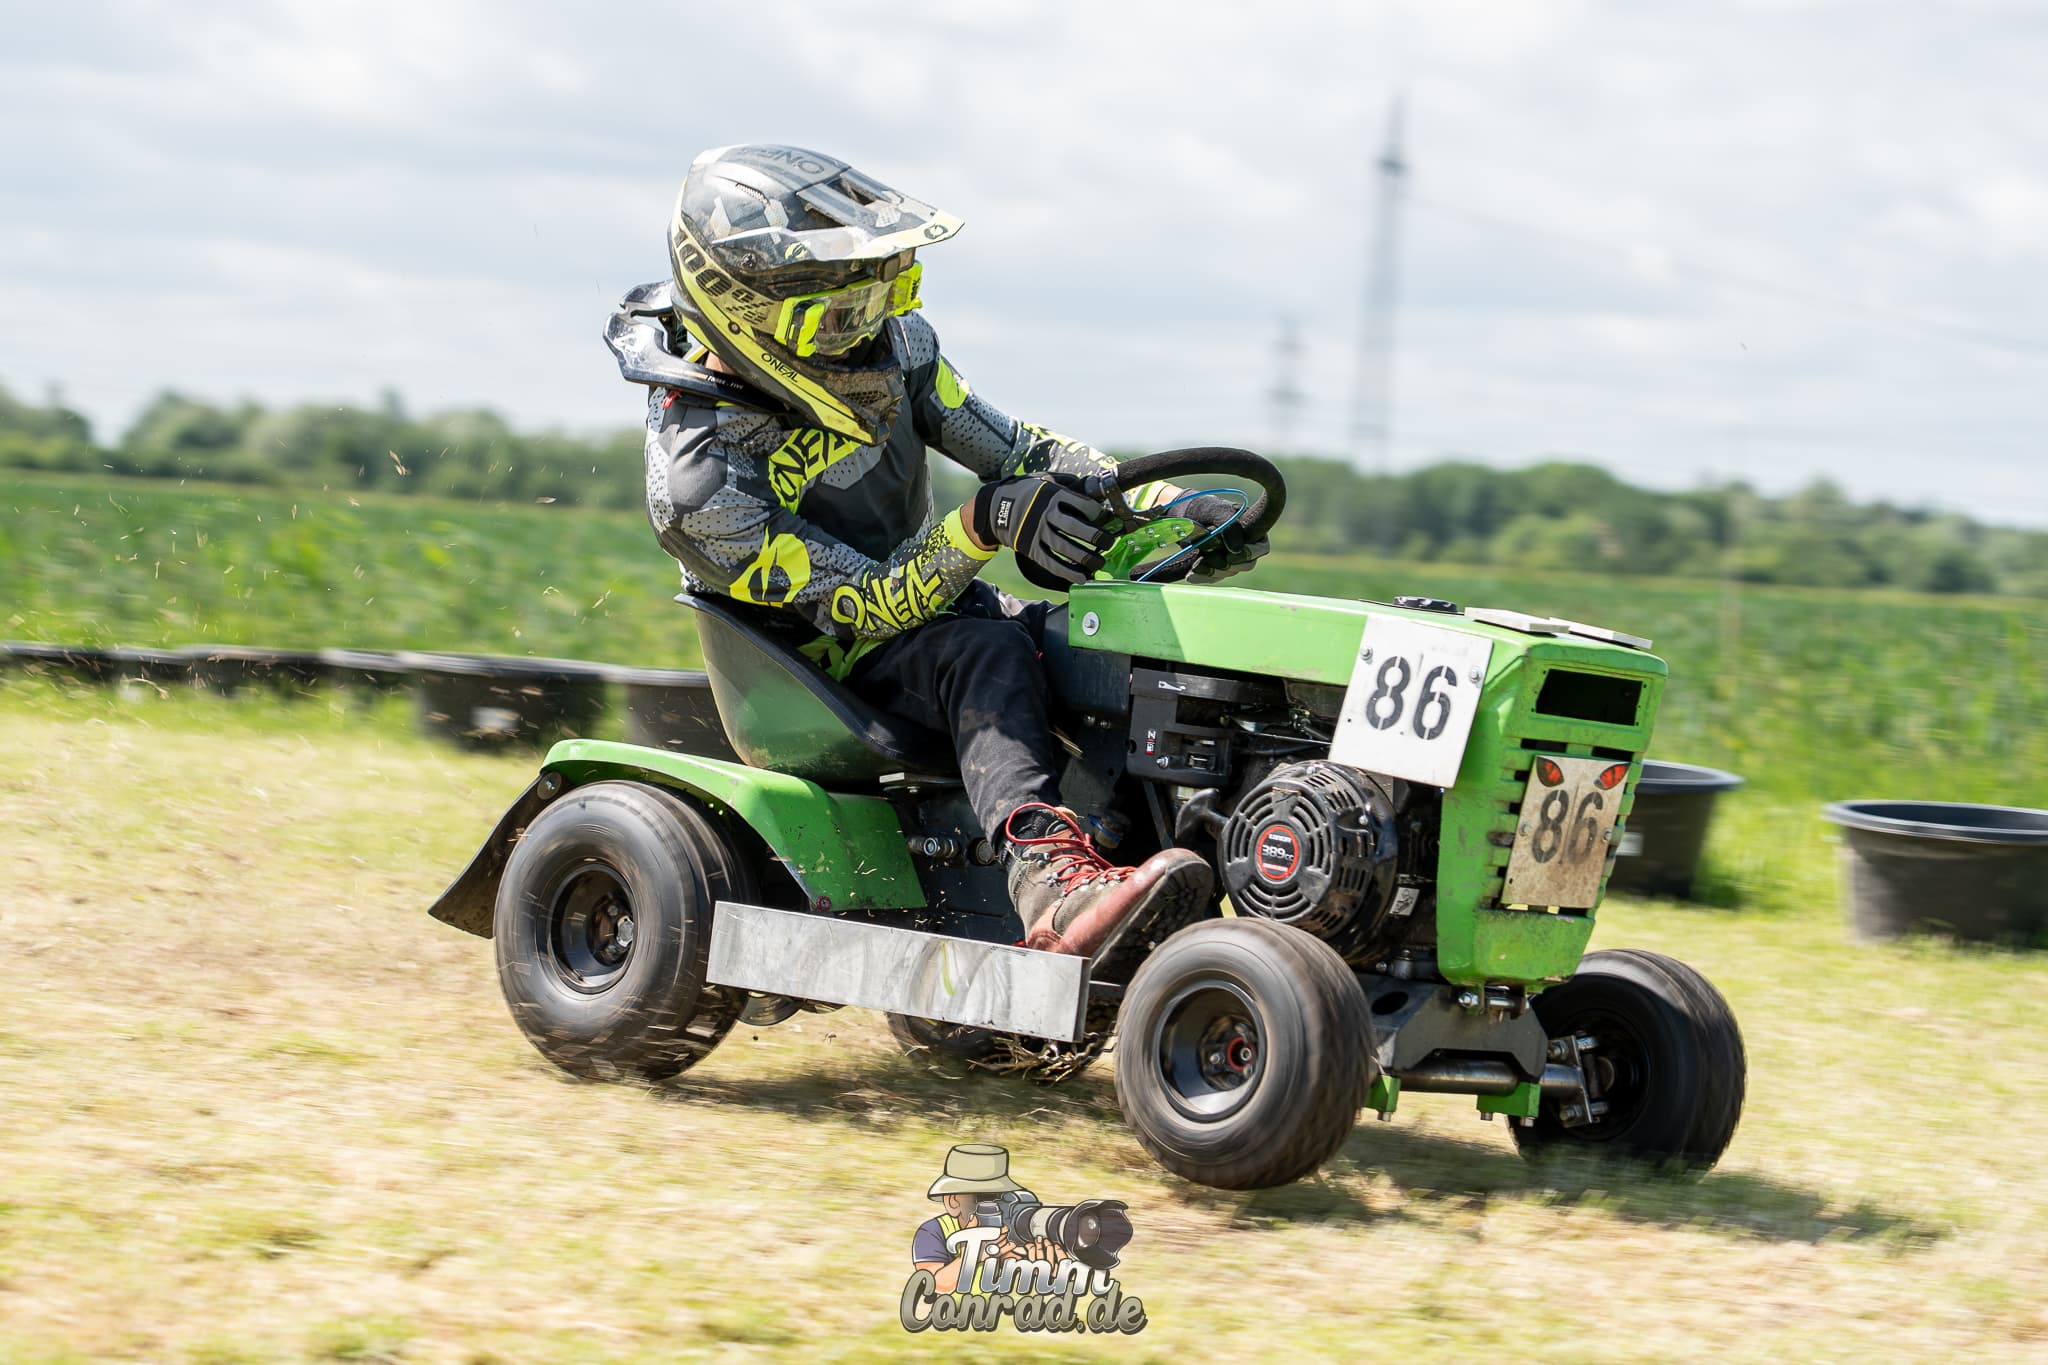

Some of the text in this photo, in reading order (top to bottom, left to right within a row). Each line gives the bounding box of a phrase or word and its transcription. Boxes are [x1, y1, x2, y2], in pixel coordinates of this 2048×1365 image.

[760, 352, 799, 383] ONEAL
[774, 430, 852, 503] ONEA
[1366, 655, 1457, 740] 86
[1261, 844, 1294, 861] 389cc
[1532, 789, 1604, 865] 86
